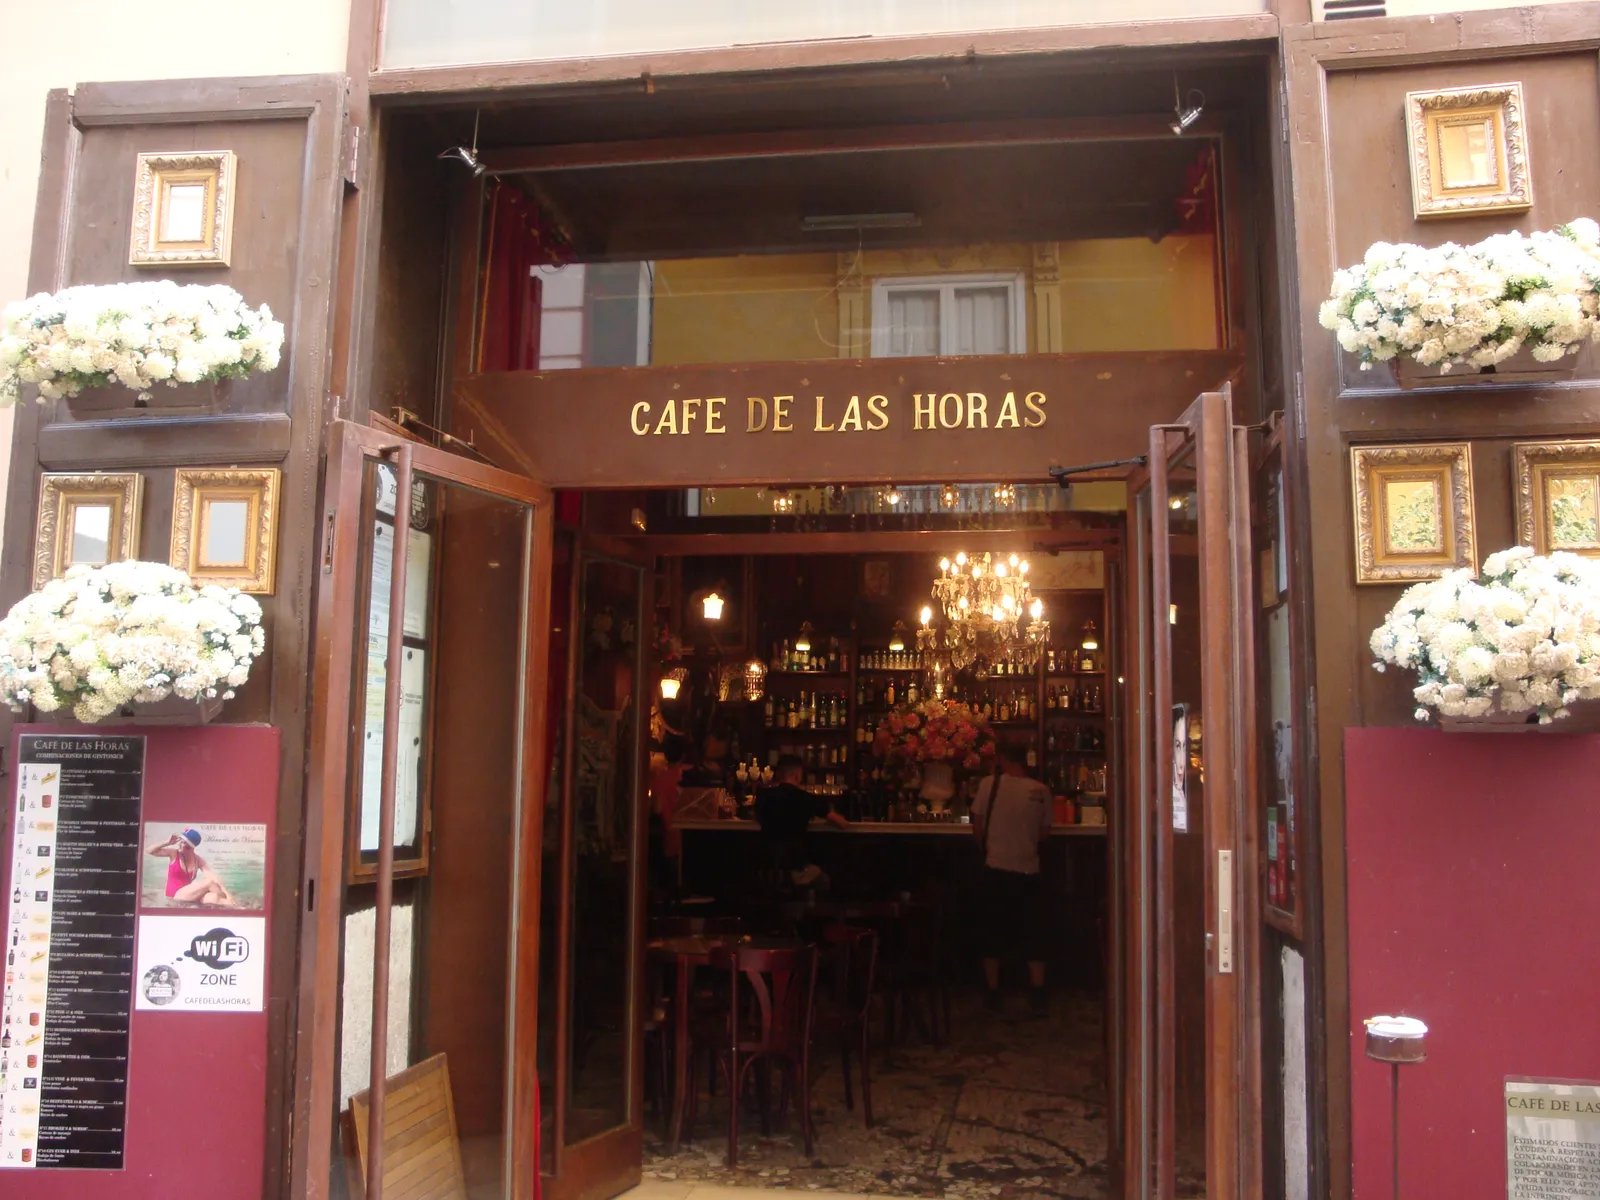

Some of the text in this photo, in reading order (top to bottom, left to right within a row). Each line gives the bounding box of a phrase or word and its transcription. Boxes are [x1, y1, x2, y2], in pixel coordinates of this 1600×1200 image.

[630, 391, 1048, 436] CAFE DE LAS HORAS
[61, 741, 73, 750] DE
[75, 741, 92, 751] LAS
[94, 740, 130, 751] HORAS
[200, 973, 237, 986] ZONE
[184, 997, 251, 1005] CAFEDELASHORAS
[1550, 1099, 1570, 1112] DE
[1513, 1135, 1559, 1146] ESTIMADOS
[1561, 1140, 1597, 1150] CLIENTES
[1558, 1148, 1596, 1157] RESPETAR
[1527, 1169, 1554, 1177] TOCAR
[1523, 1176, 1539, 1184] POR
[1514, 1183, 1543, 1192] AYUDA
